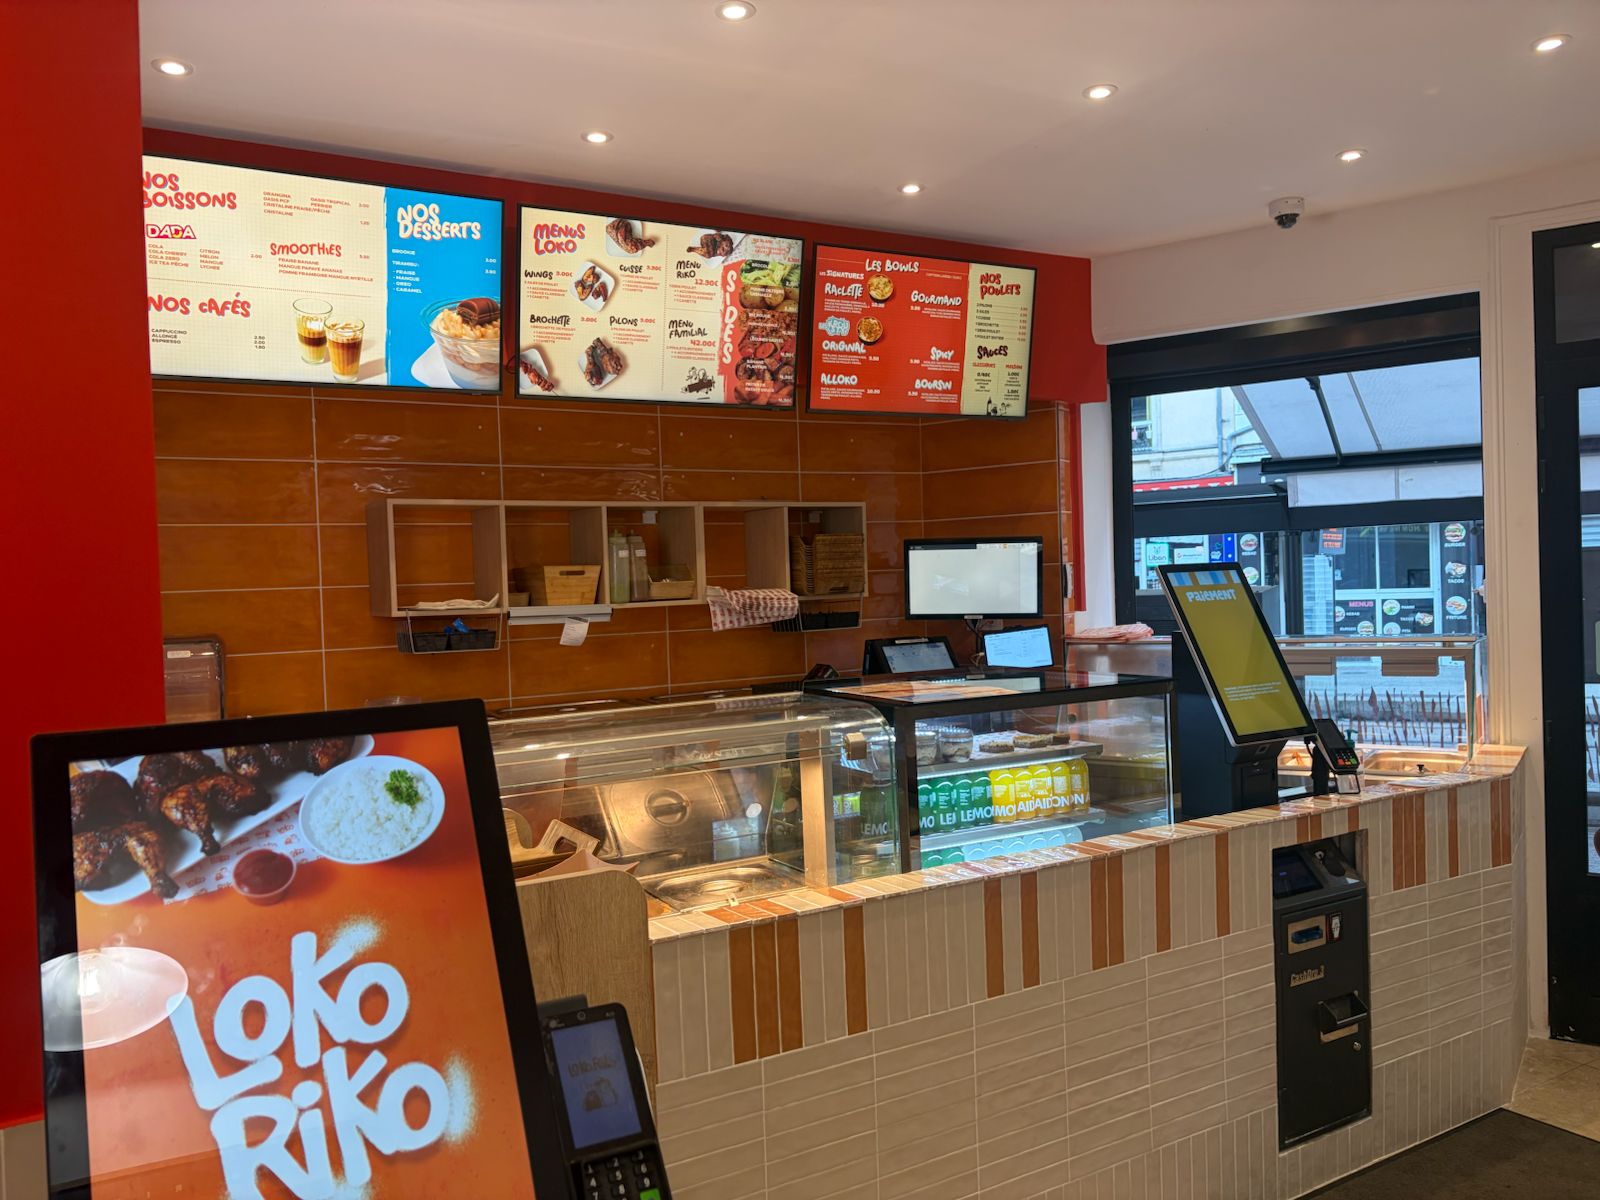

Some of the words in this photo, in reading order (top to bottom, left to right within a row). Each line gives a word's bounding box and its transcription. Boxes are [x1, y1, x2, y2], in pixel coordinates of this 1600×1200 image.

[397, 203, 440, 224] NOS
[399, 220, 481, 240] DESSERTS
[534, 223, 586, 239] MENUS
[534, 238, 577, 255] LOKO
[620, 264, 643, 273] CUISSE
[676, 260, 702, 270] MENU
[865, 259, 882, 272] LES
[885, 259, 920, 272] BOWLS
[524, 269, 553, 280] WINGS
[827, 270, 864, 280] SIGNATURES
[980, 272, 1002, 284] NOS
[825, 282, 863, 299] RACLETTE
[980, 284, 1021, 300] POULETS
[148, 294, 190, 315] NOS
[911, 290, 962, 306] GOURMAND
[722, 270, 738, 364] SIDES
[669, 320, 693, 329] MENU
[669, 328, 708, 339] FAMILIAL
[822, 340, 866, 353] ORIGINAL
[977, 345, 1008, 359] SAUCES
[820, 372, 858, 385] ALLOKO
[166, 918, 410, 1110] LOKO
